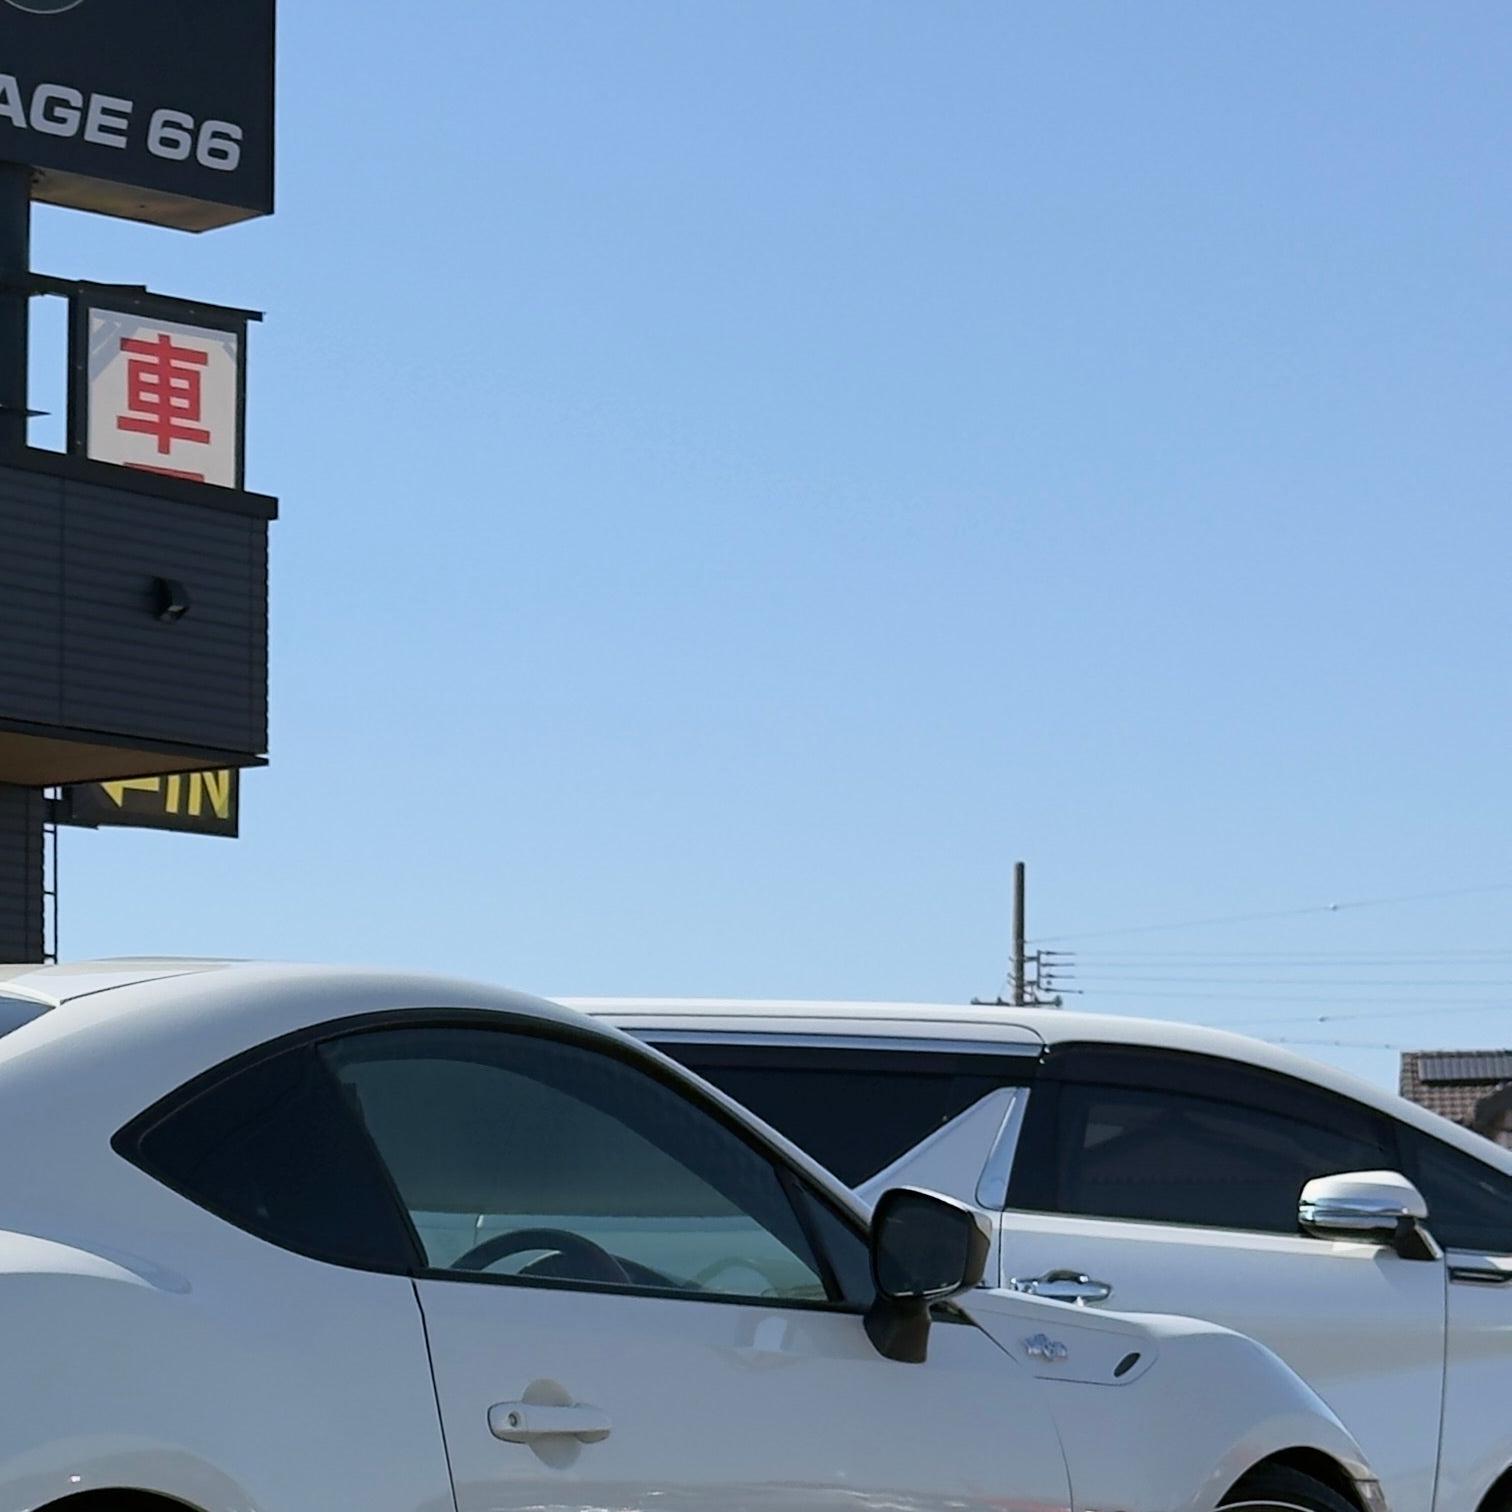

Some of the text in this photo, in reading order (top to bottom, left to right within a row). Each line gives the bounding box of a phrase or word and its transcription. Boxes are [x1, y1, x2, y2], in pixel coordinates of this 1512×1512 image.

[147, 109, 244, 172] 66
[117, 333, 211, 484] 車
[165, 769, 230, 820] IN
